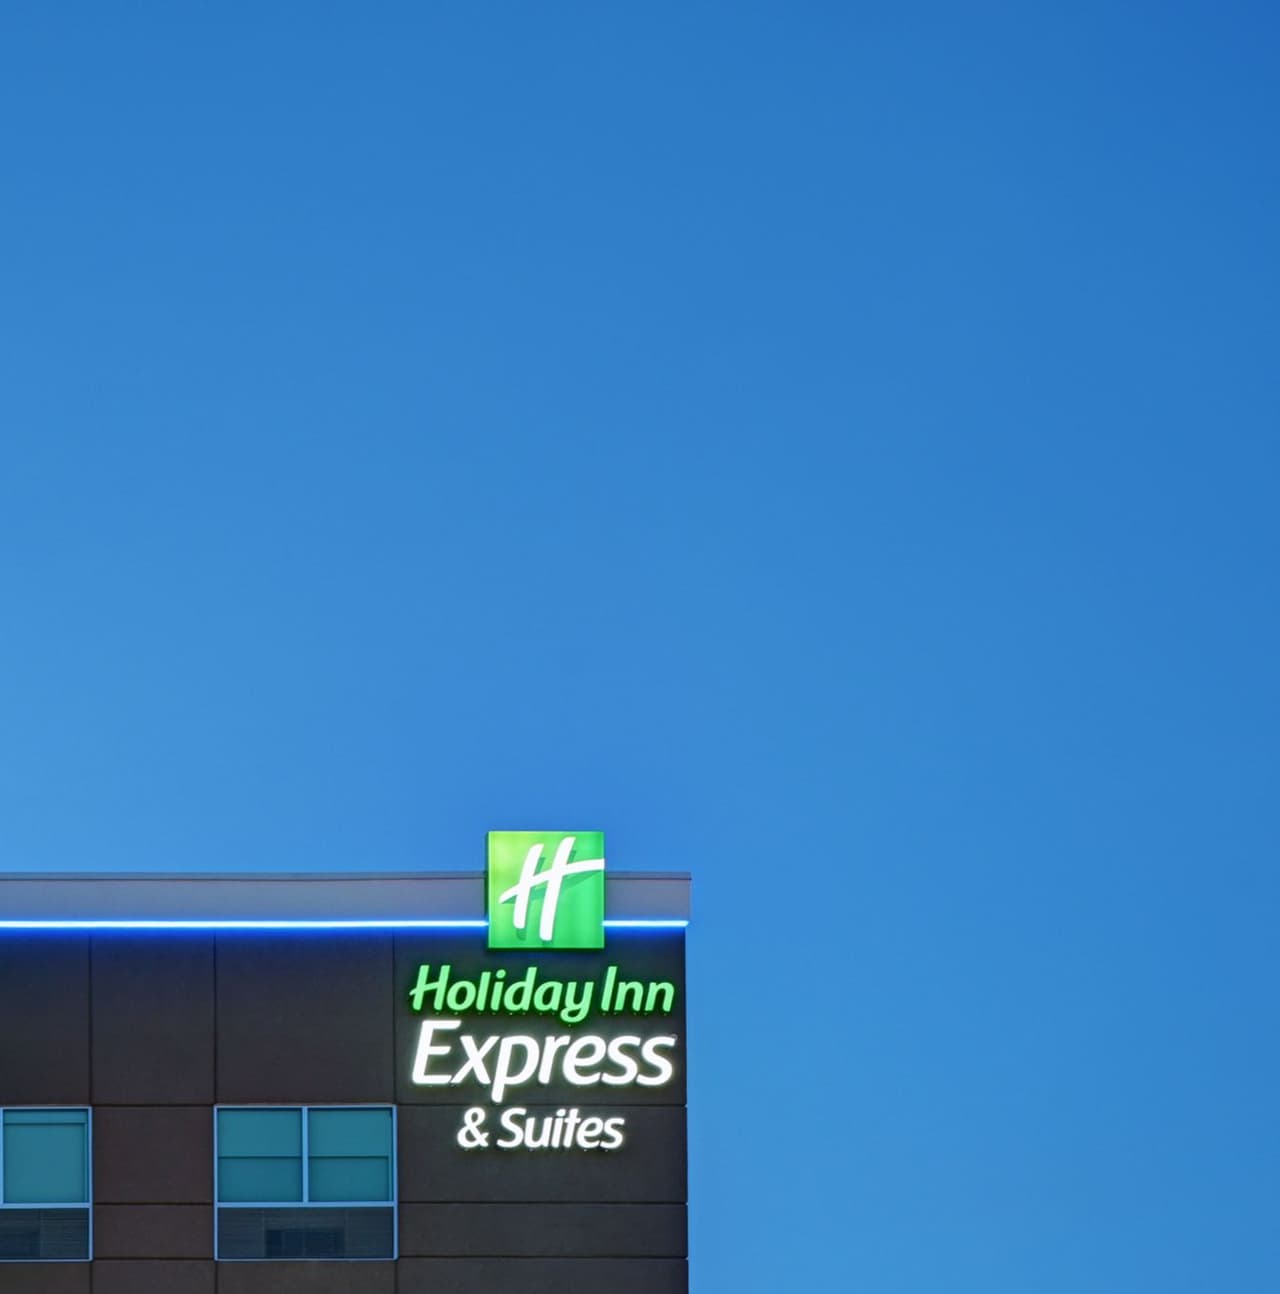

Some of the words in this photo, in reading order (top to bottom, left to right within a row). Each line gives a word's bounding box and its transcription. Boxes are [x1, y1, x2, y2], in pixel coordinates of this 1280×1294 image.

[409, 965, 594, 1023] Holiday
[600, 966, 675, 1012] Inn
[411, 1020, 678, 1103] Express
[457, 1106, 489, 1148] &
[496, 1107, 625, 1149] Suites
